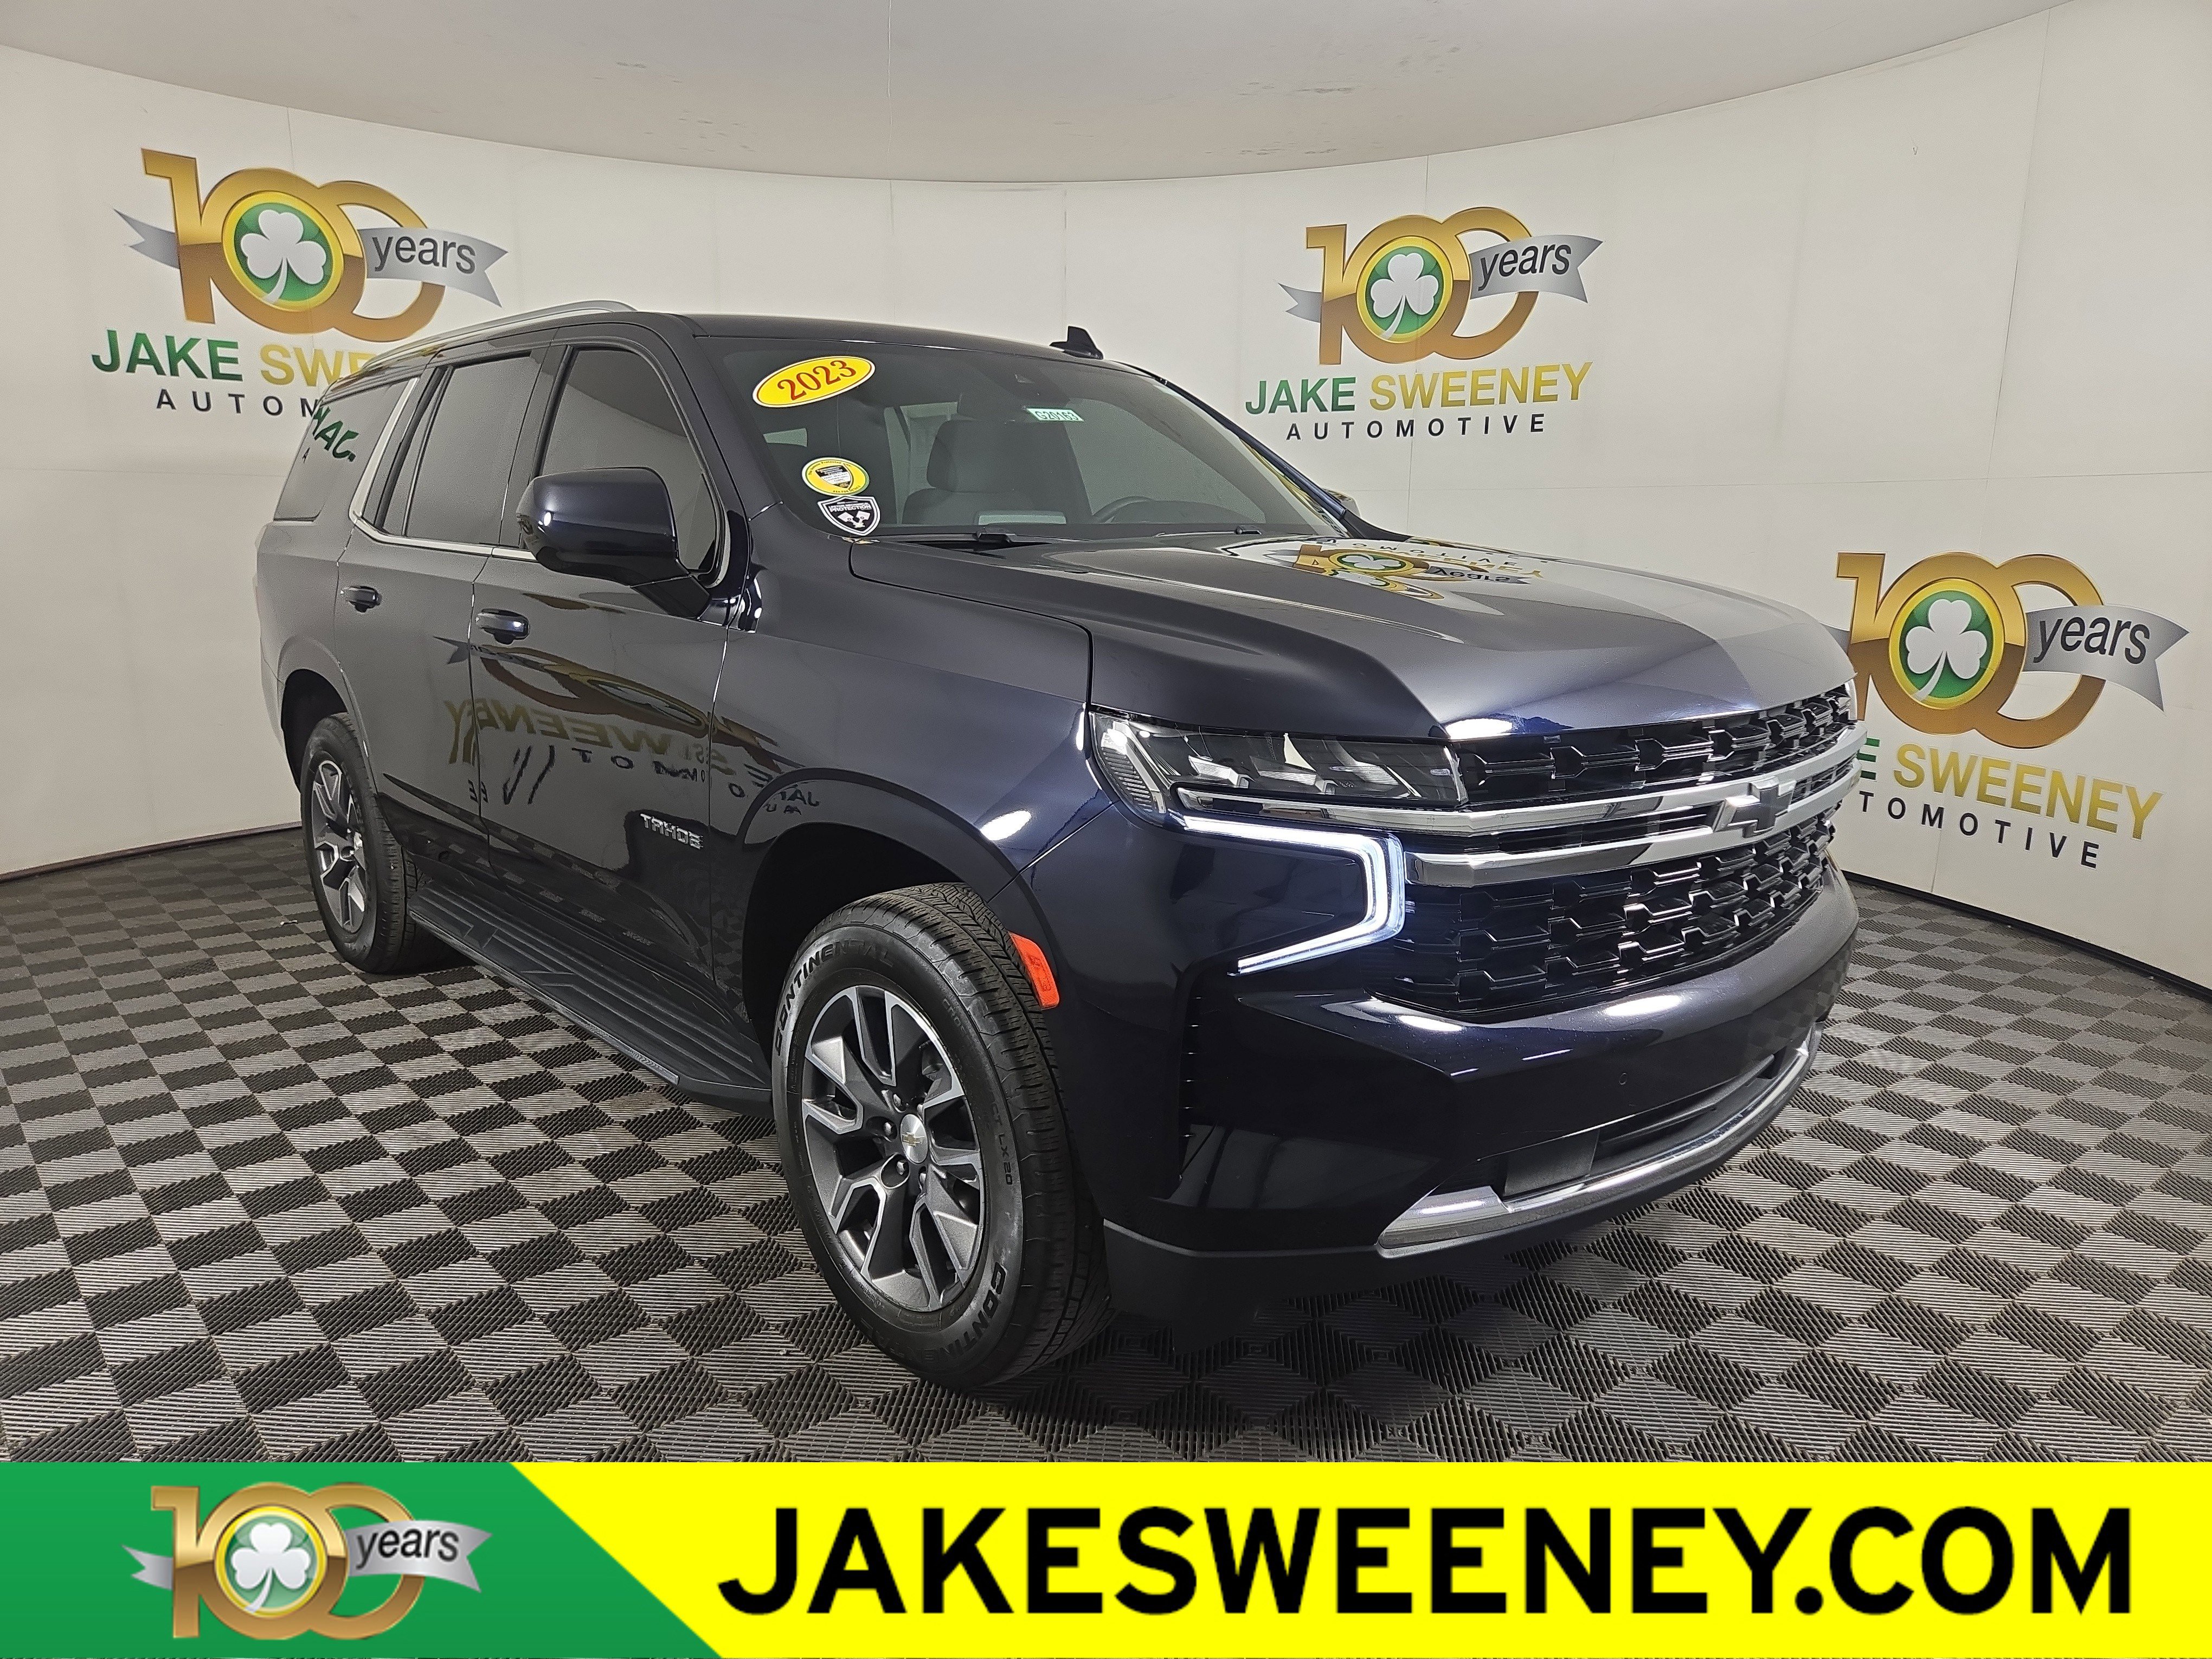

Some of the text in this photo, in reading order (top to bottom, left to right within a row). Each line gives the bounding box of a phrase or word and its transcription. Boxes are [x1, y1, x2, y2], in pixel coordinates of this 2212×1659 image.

[140, 147, 446, 343] 100
[371, 232, 477, 274] years
[1477, 243, 1572, 291] years
[1306, 207, 1539, 365] 100
[91, 329, 243, 382] JAKE
[777, 360, 856, 401] 2023
[1245, 362, 1593, 415] JAKE SWEENEY
[1034, 411, 1079, 420] G20163
[1285, 413, 1545, 441] AUTOMOTIVE
[1837, 551, 2106, 749] 100
[2032, 616, 2151, 665] years
[1894, 743, 2165, 840] SWEENEY
[640, 813, 703, 850] TAHOE
[1859, 790, 2099, 869] TOMOTIVE
